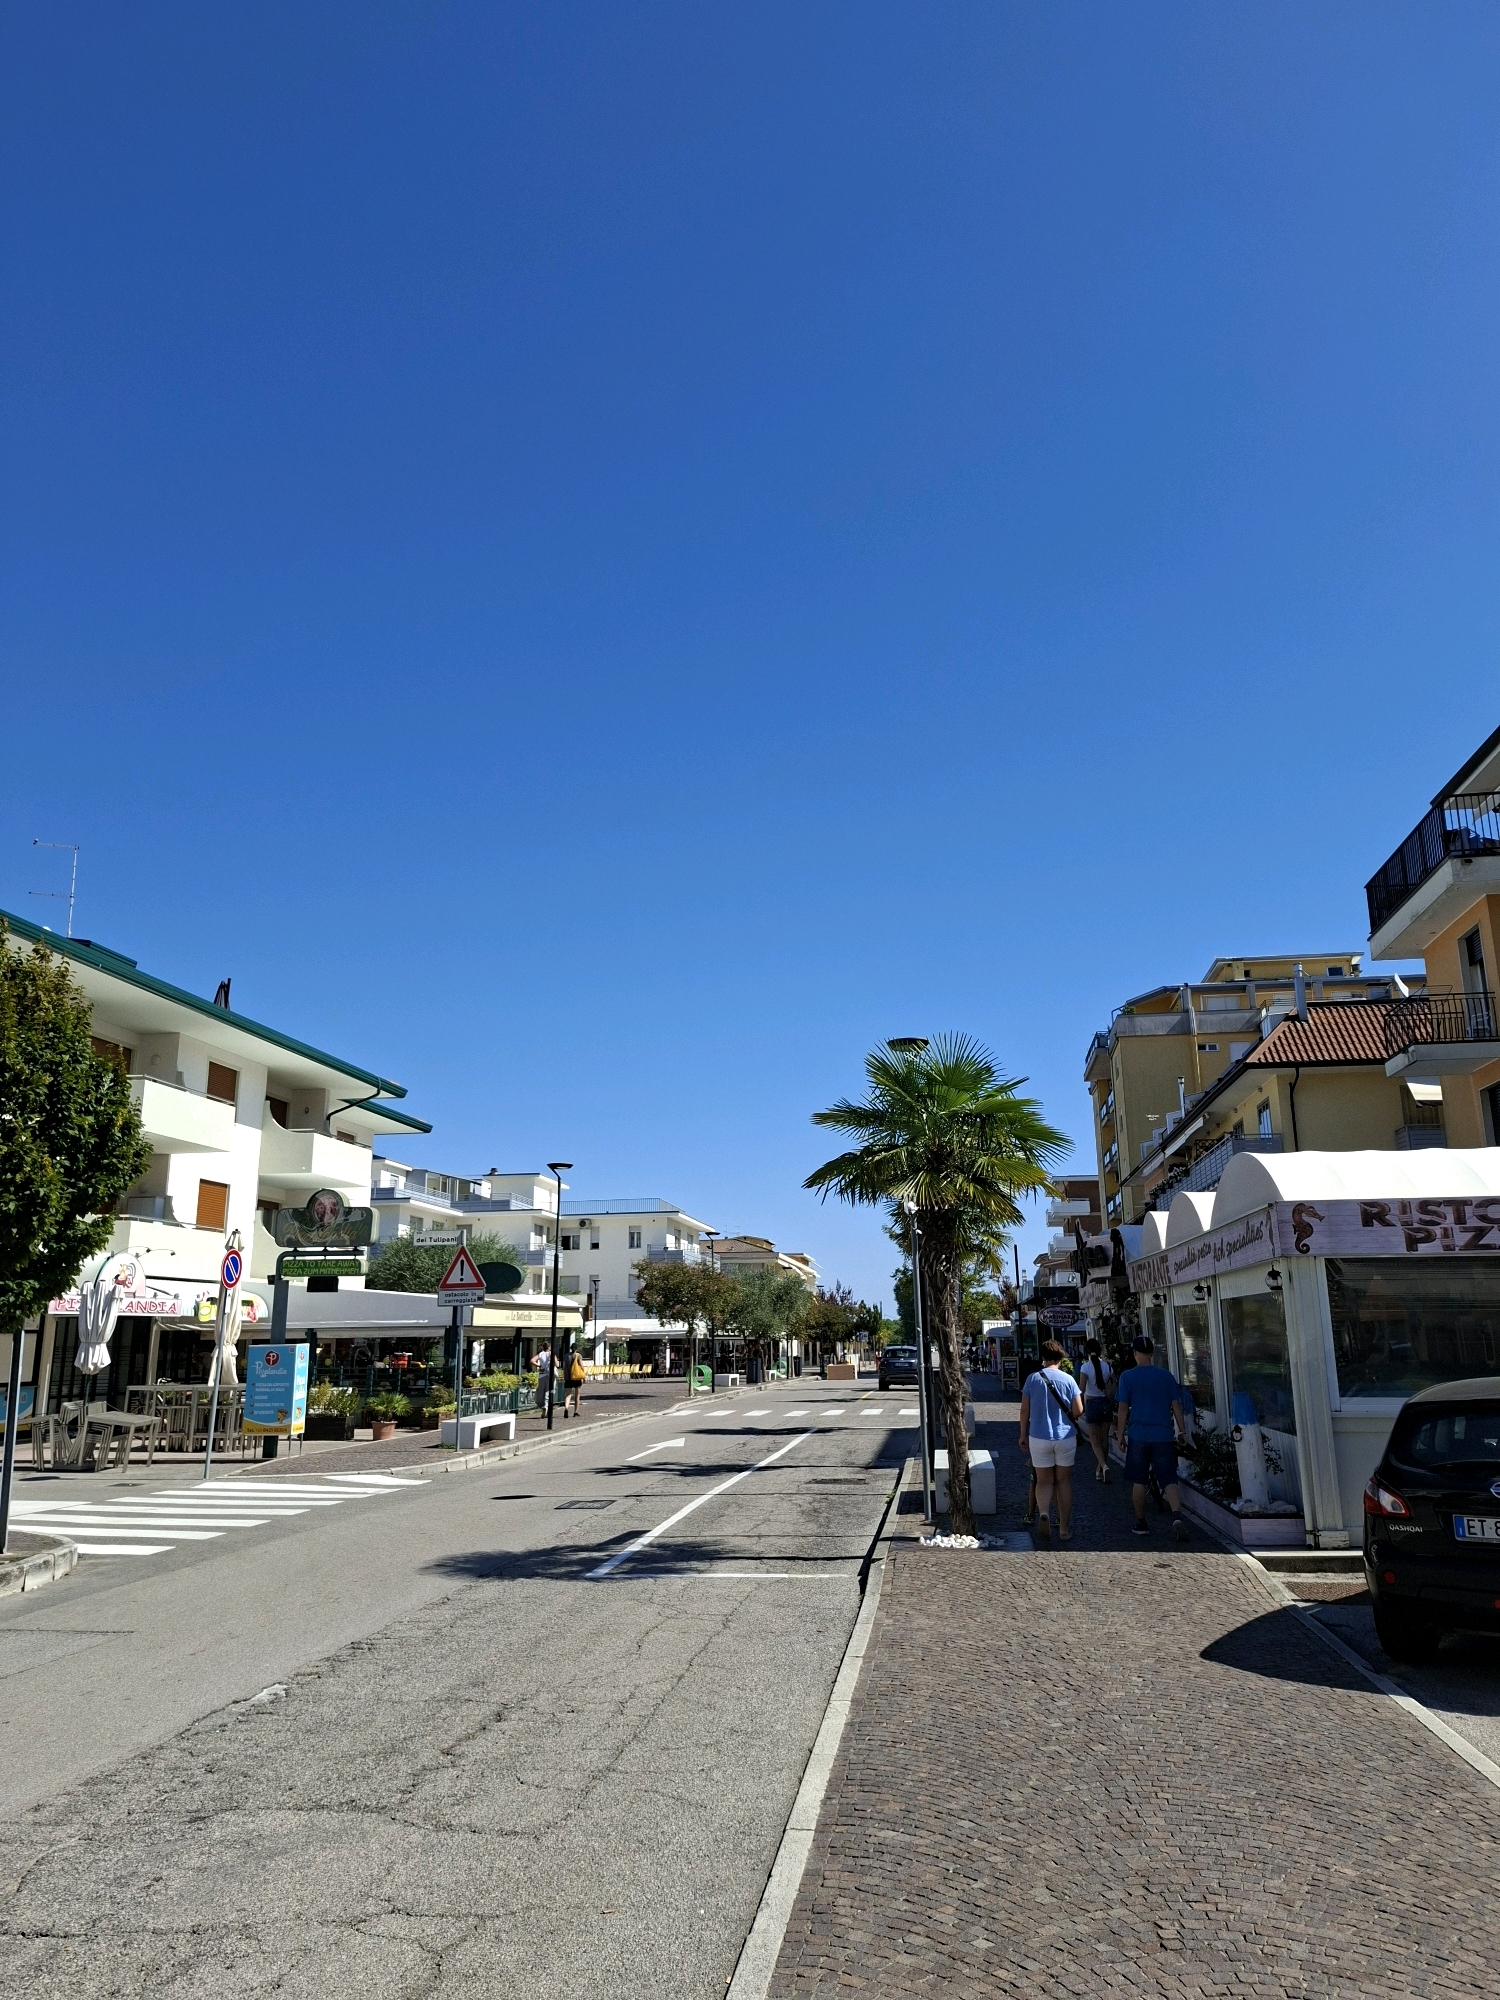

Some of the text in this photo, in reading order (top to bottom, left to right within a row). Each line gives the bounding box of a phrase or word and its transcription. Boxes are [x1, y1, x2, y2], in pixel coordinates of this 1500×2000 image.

[1402, 1226, 1500, 1252] PIZ
[282, 1260, 304, 1268] PIZZA
[306, 1260, 316, 1268] TO
[57, 1298, 177, 1313] PIANDIA
[1389, 1523, 1423, 1533] QASHQAI
[1466, 1518, 1487, 1537] ET
